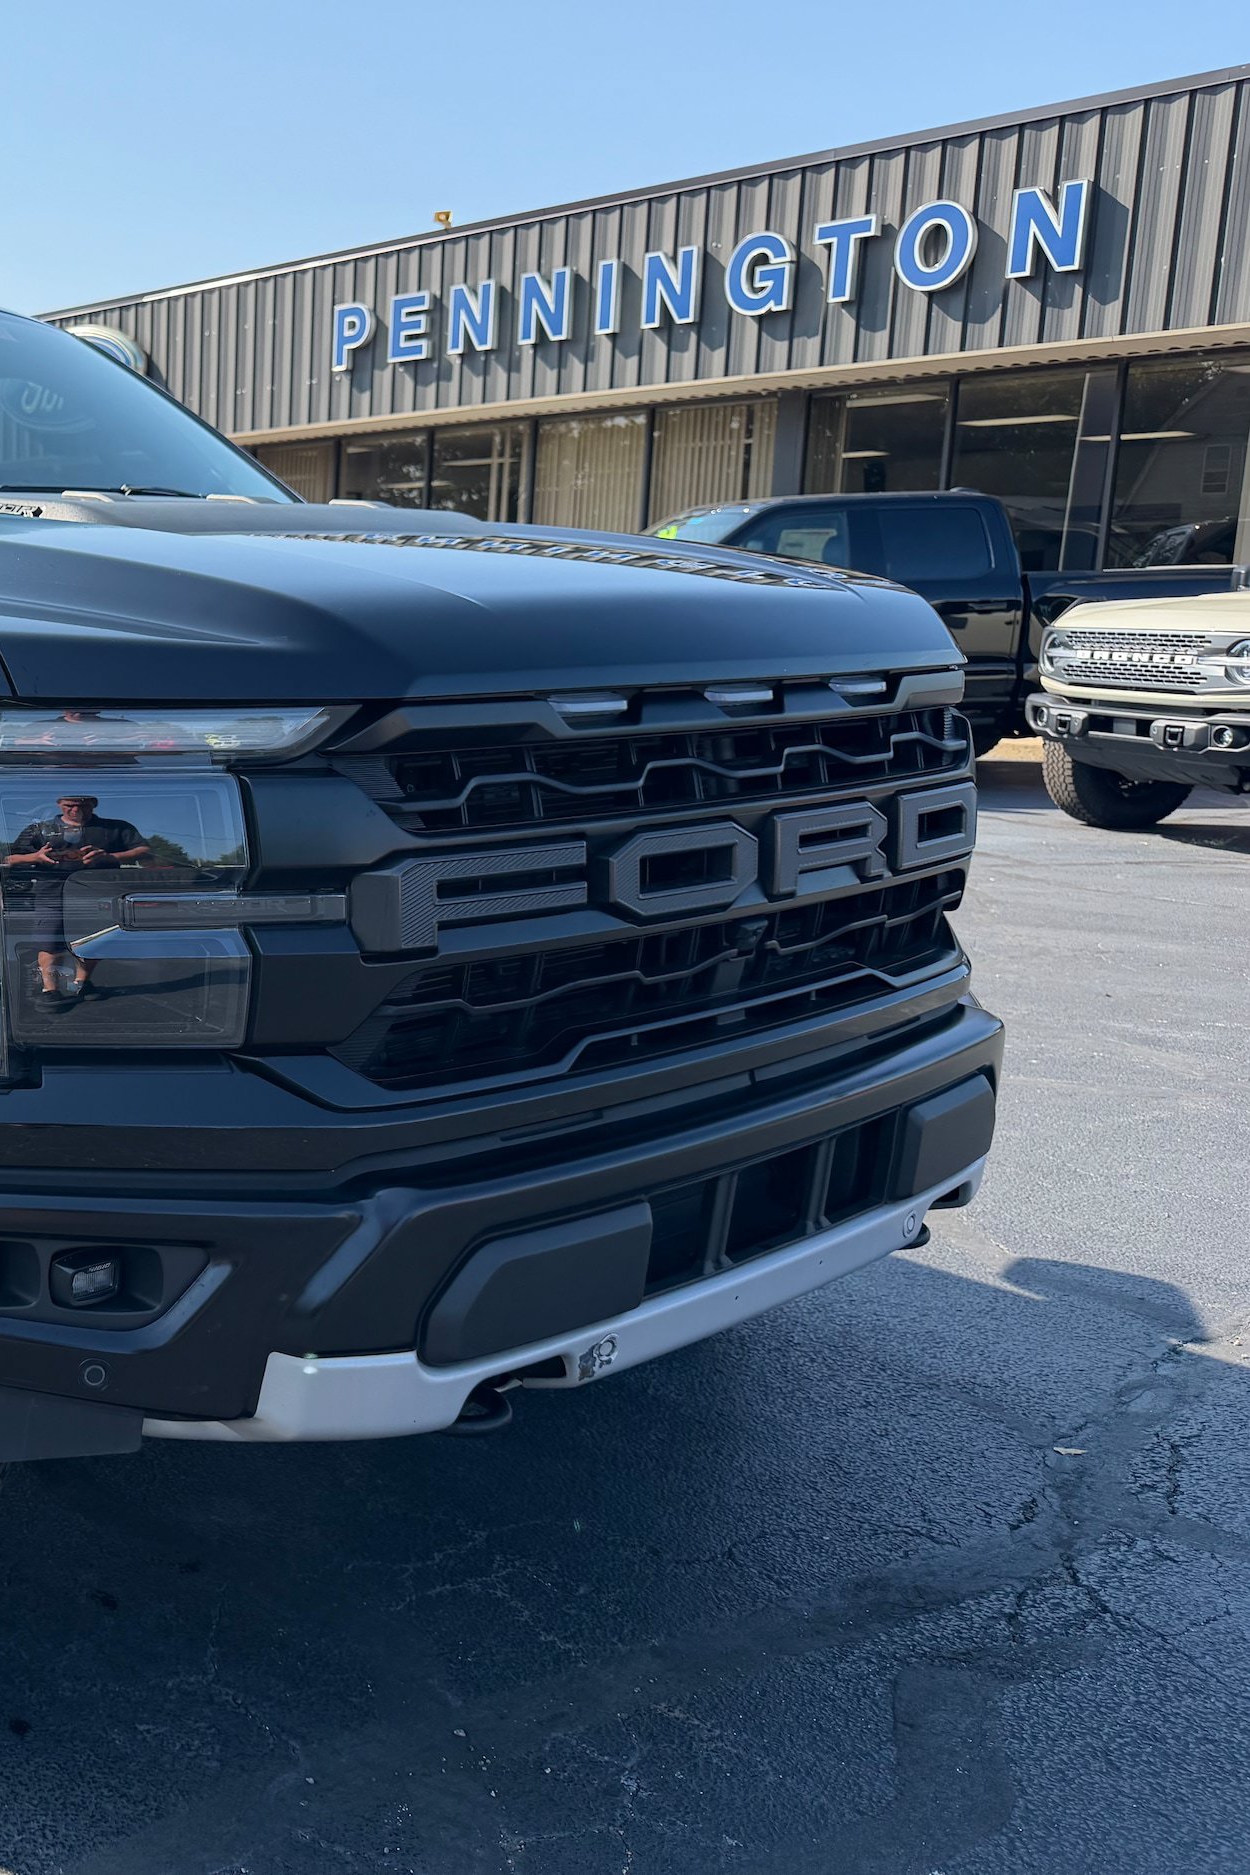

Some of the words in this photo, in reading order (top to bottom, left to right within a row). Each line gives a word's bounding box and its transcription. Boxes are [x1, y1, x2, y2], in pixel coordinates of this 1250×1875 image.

[332, 178, 1093, 373] PENNINGTON
[1076, 649, 1194, 665] BRONCO
[365, 780, 978, 957] FORD
